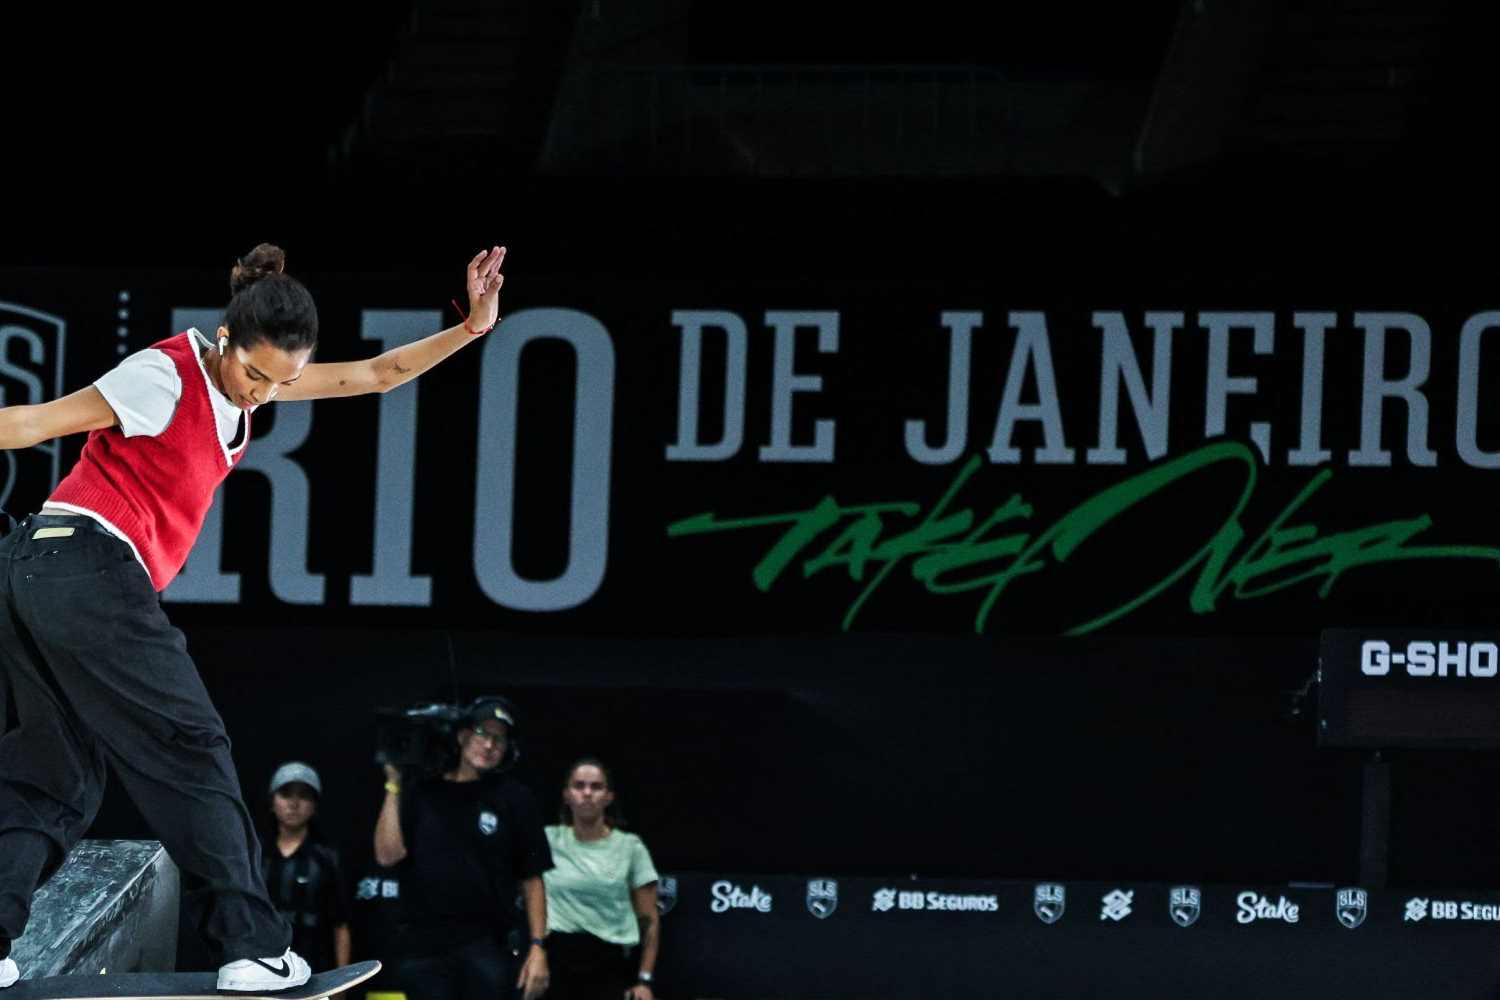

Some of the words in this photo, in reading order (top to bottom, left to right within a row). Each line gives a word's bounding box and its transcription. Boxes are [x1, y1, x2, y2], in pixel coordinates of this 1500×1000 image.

[162, 307, 616, 612] RIO
[665, 310, 840, 461] DE
[905, 310, 1500, 469] JANEIRO
[711, 880, 772, 913] Stake
[809, 879, 837, 897] SLS
[1037, 885, 1064, 901] SLS
[1172, 888, 1198, 905] SLS
[899, 892, 924, 909] BB
[1236, 891, 1299, 924] Stake
[1339, 890, 1365, 907] SLS
[1432, 901, 1457, 920] BB
